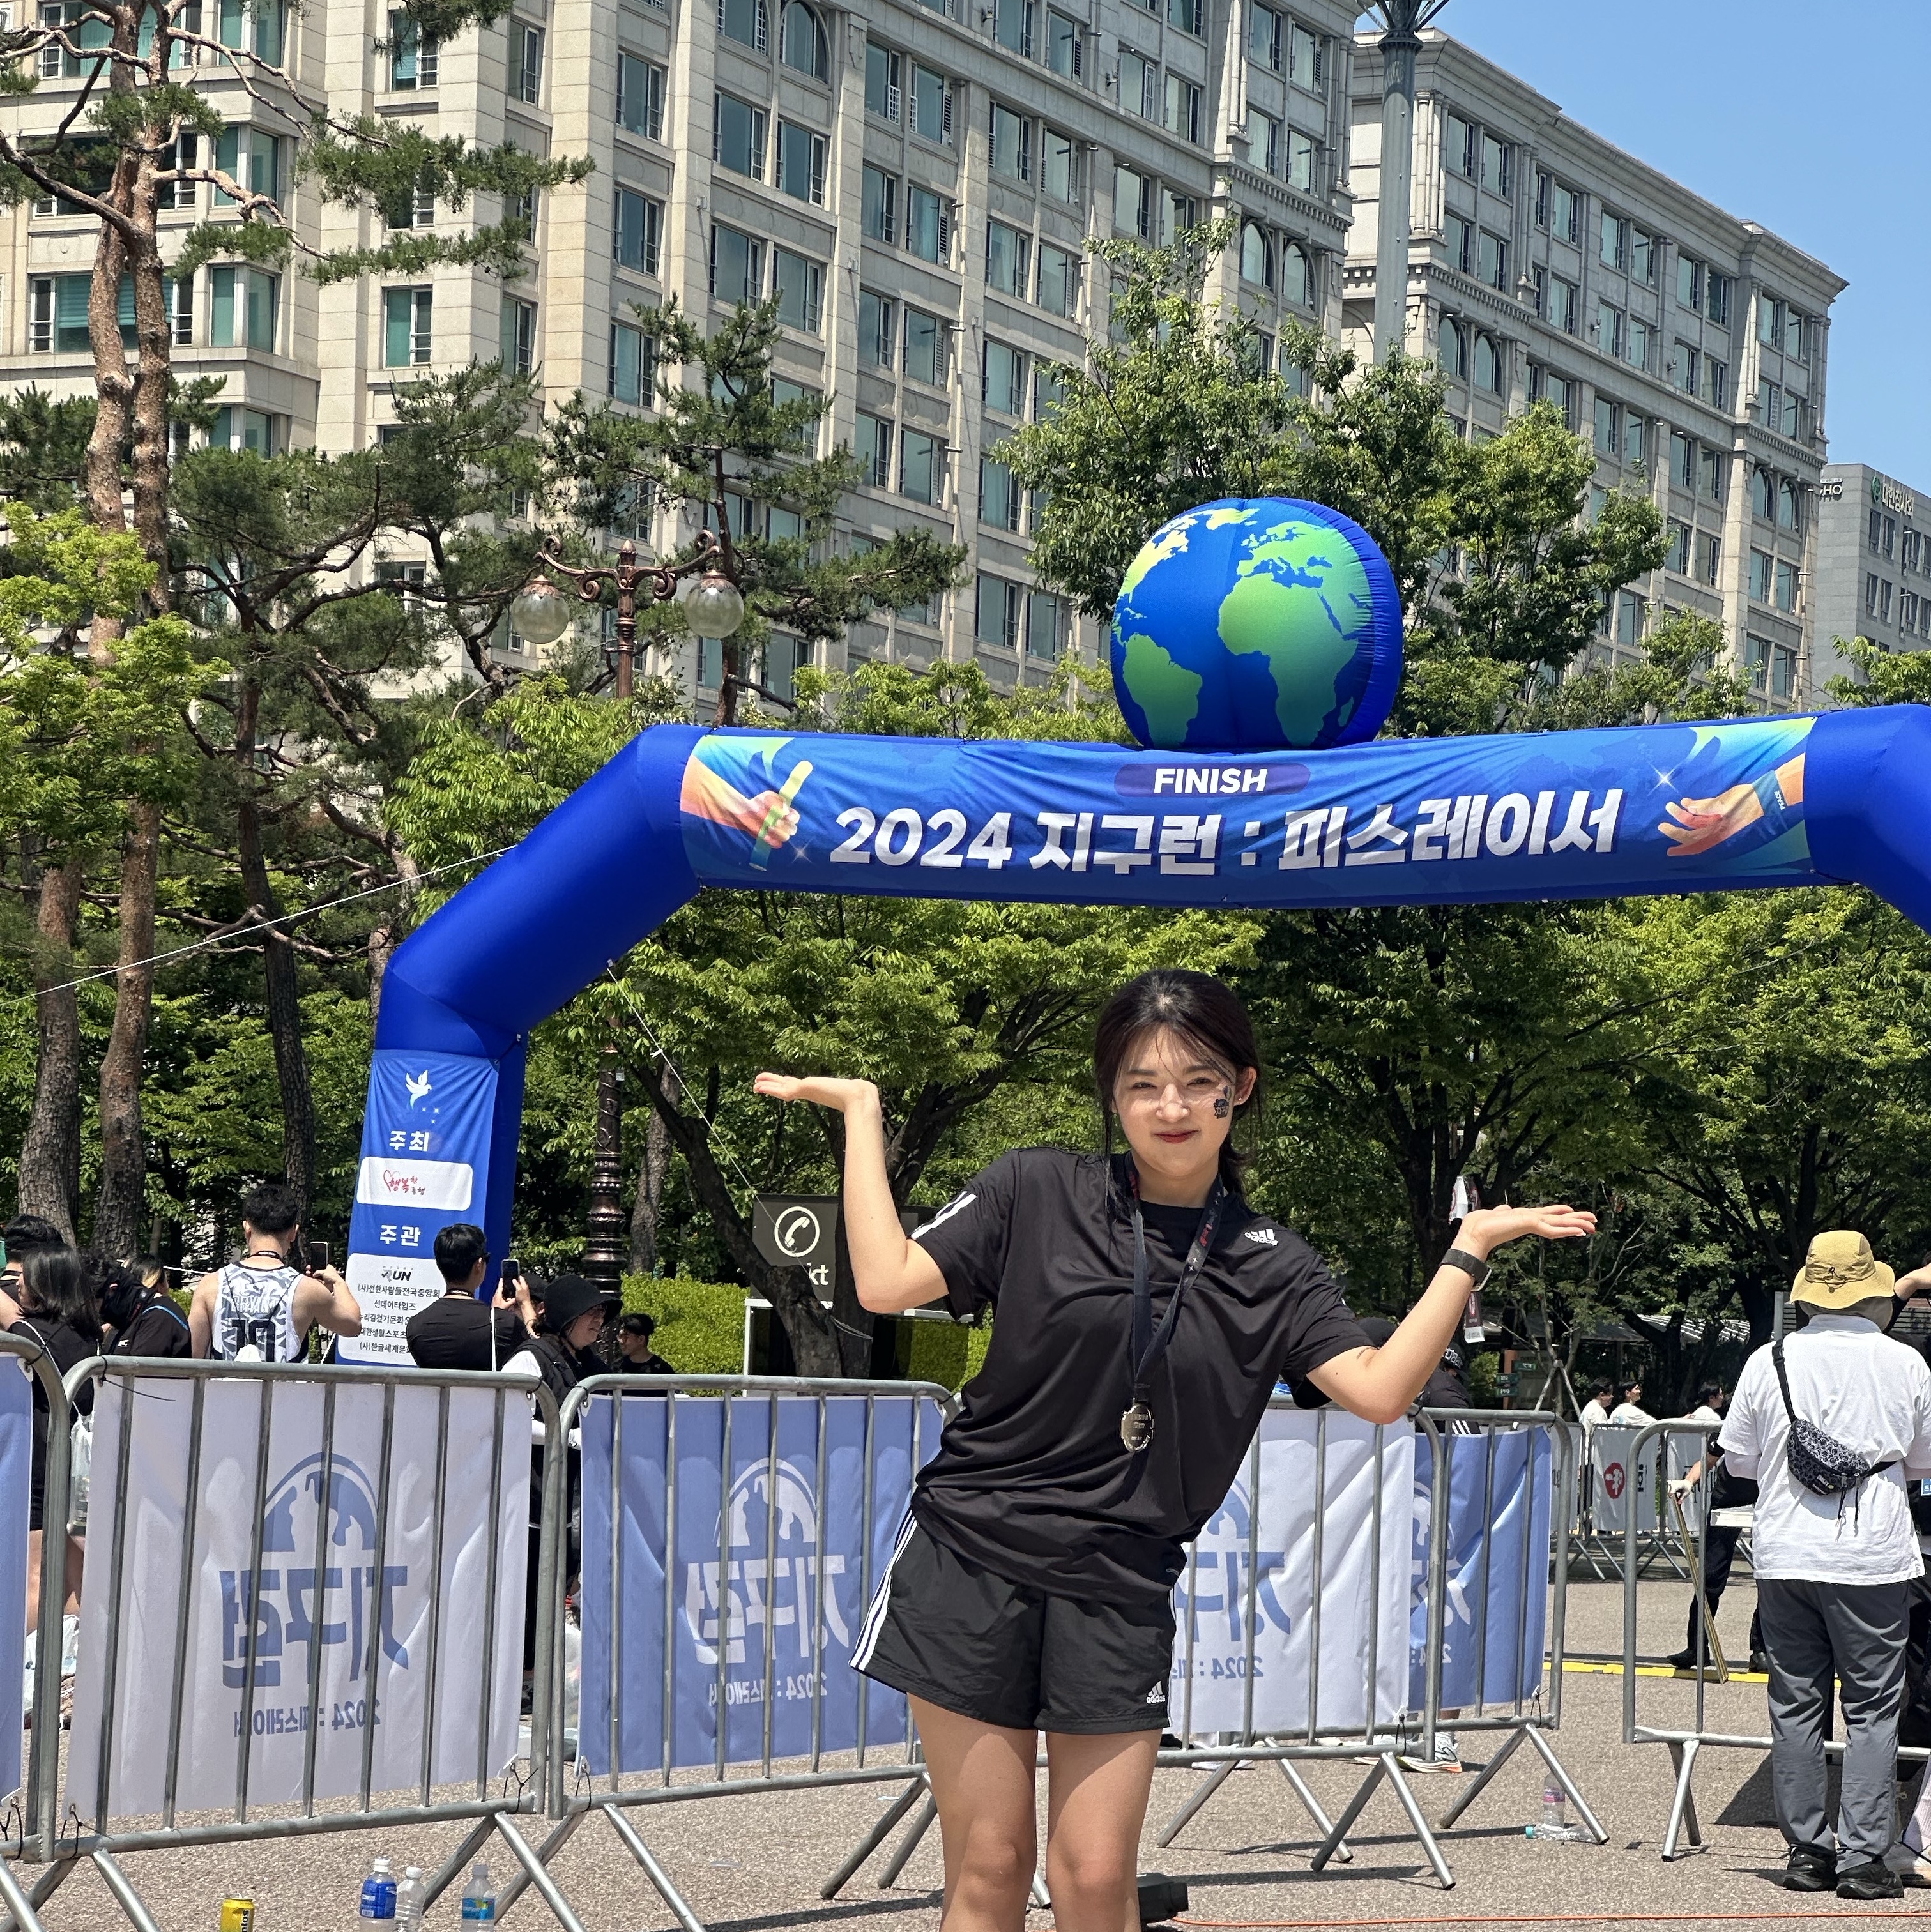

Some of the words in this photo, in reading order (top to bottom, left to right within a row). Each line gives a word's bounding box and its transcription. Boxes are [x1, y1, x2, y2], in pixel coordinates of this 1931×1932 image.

[1820, 485, 1842, 496] HO
[1153, 768, 1267, 794] FINISH
[830, 807, 1012, 870] 2024
[1029, 812, 1223, 876] 지구런
[1240, 821, 1260, 866] :
[1279, 789, 1623, 871] 피스레이서
[389, 1130, 430, 1152] 주최
[379, 1225, 421, 1246] 주관
[1244, 1231, 1278, 1246] adidas
[808, 1263, 829, 1285] kt
[374, 1300, 416, 1311] 선데이타임즈
[361, 1328, 407, 1339] 대한생활스포츠
